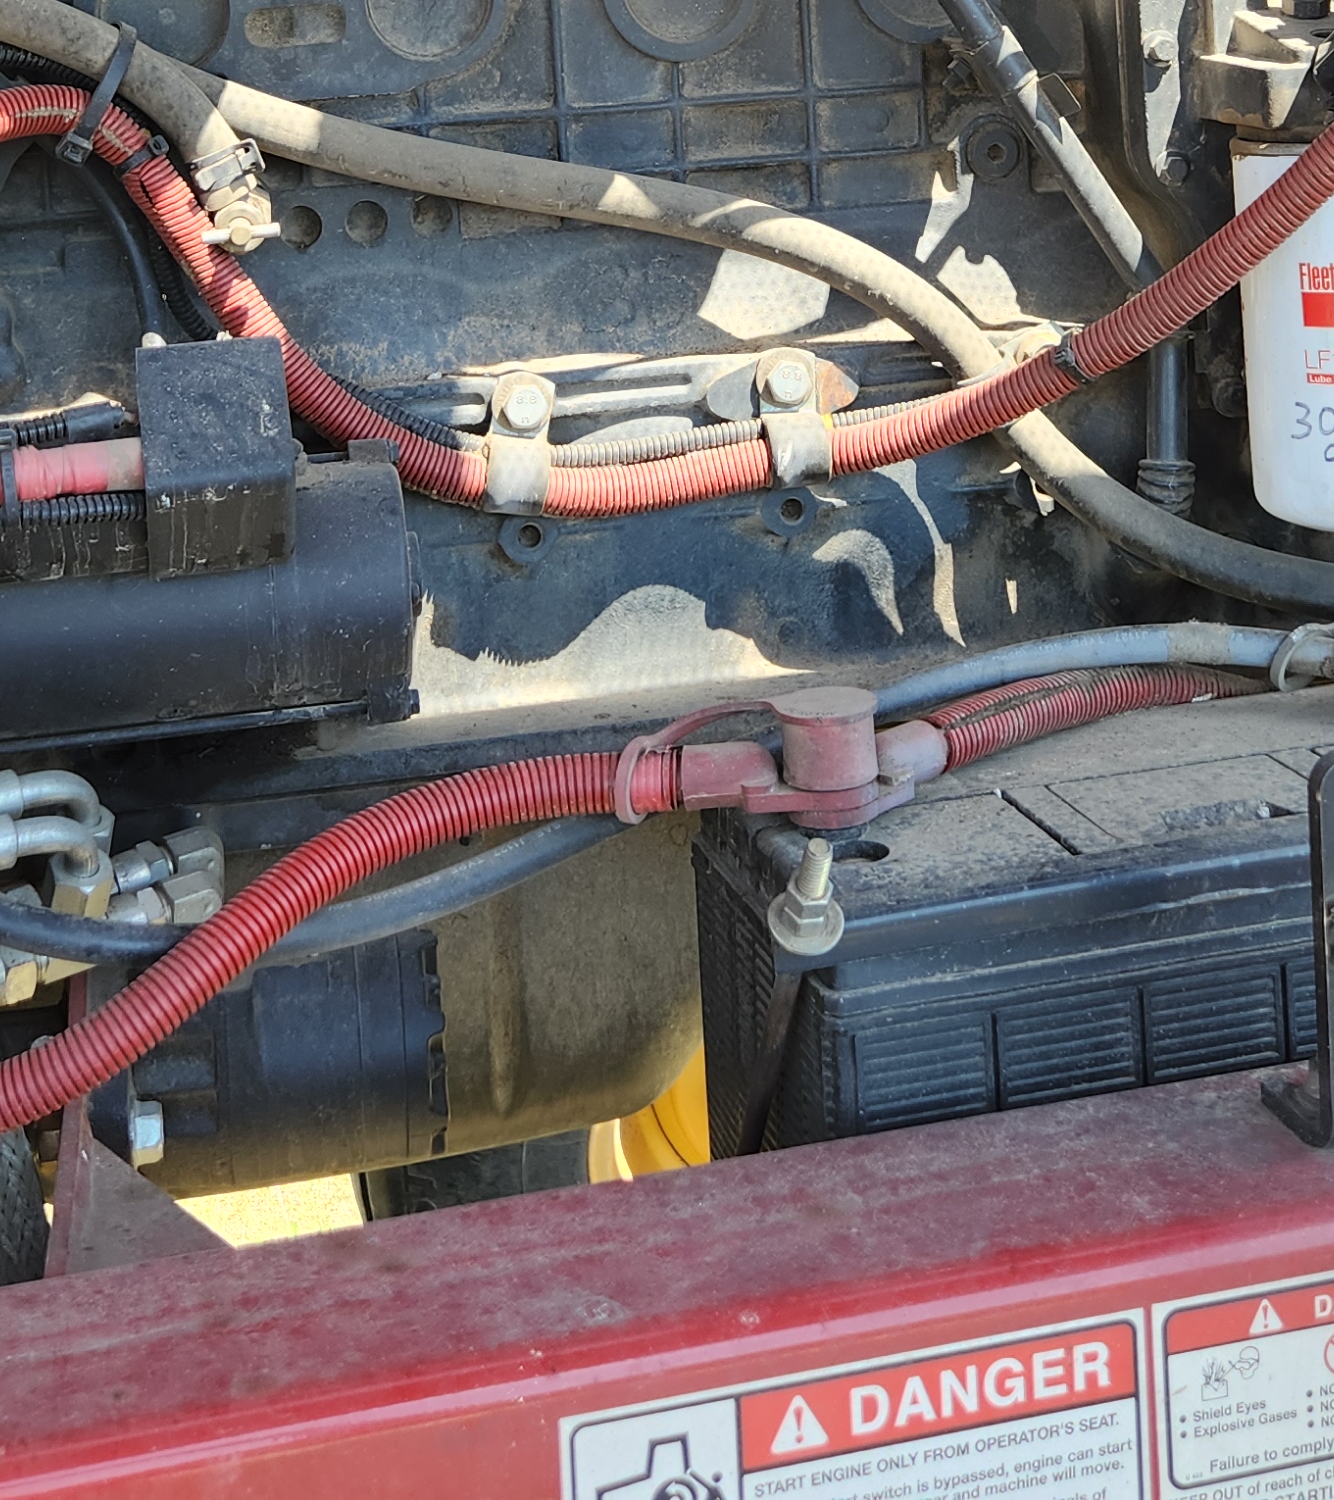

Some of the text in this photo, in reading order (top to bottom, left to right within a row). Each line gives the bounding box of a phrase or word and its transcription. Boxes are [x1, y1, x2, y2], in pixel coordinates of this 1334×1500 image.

[1308, 374, 1333, 384] Lube
[849, 1340, 1111, 1437] DANGER
[1192, 1399, 1267, 1423] Shield Eyes
[1193, 1408, 1298, 1439] Explosive Gases
[754, 1412, 1120, 1498] START ENGINE ONLY FROM OPERATOR'S SEAT.
[866, 1480, 912, 1500] switch
[916, 1479, 930, 1493] is
[934, 1463, 1010, 1491] bypassed,
[1013, 1452, 1063, 1475] engine
[1067, 1449, 1094, 1463] can
[1098, 1437, 1133, 1457] start
[1209, 1450, 1260, 1474] Failure
[1263, 1446, 1278, 1462] to
[1282, 1434, 1334, 1458] comply
[953, 1485, 980, 1500] and
[984, 1472, 1048, 1497] machine
[1052, 1466, 1077, 1483] will
[1081, 1458, 1125, 1477] move.
[1092, 1487, 1107, 1500] of
[1212, 1484, 1244, 1500] OUT
[1247, 1480, 1261, 1496] of
[1264, 1473, 1304, 1493] reach
[1306, 1469, 1321, 1484] of
